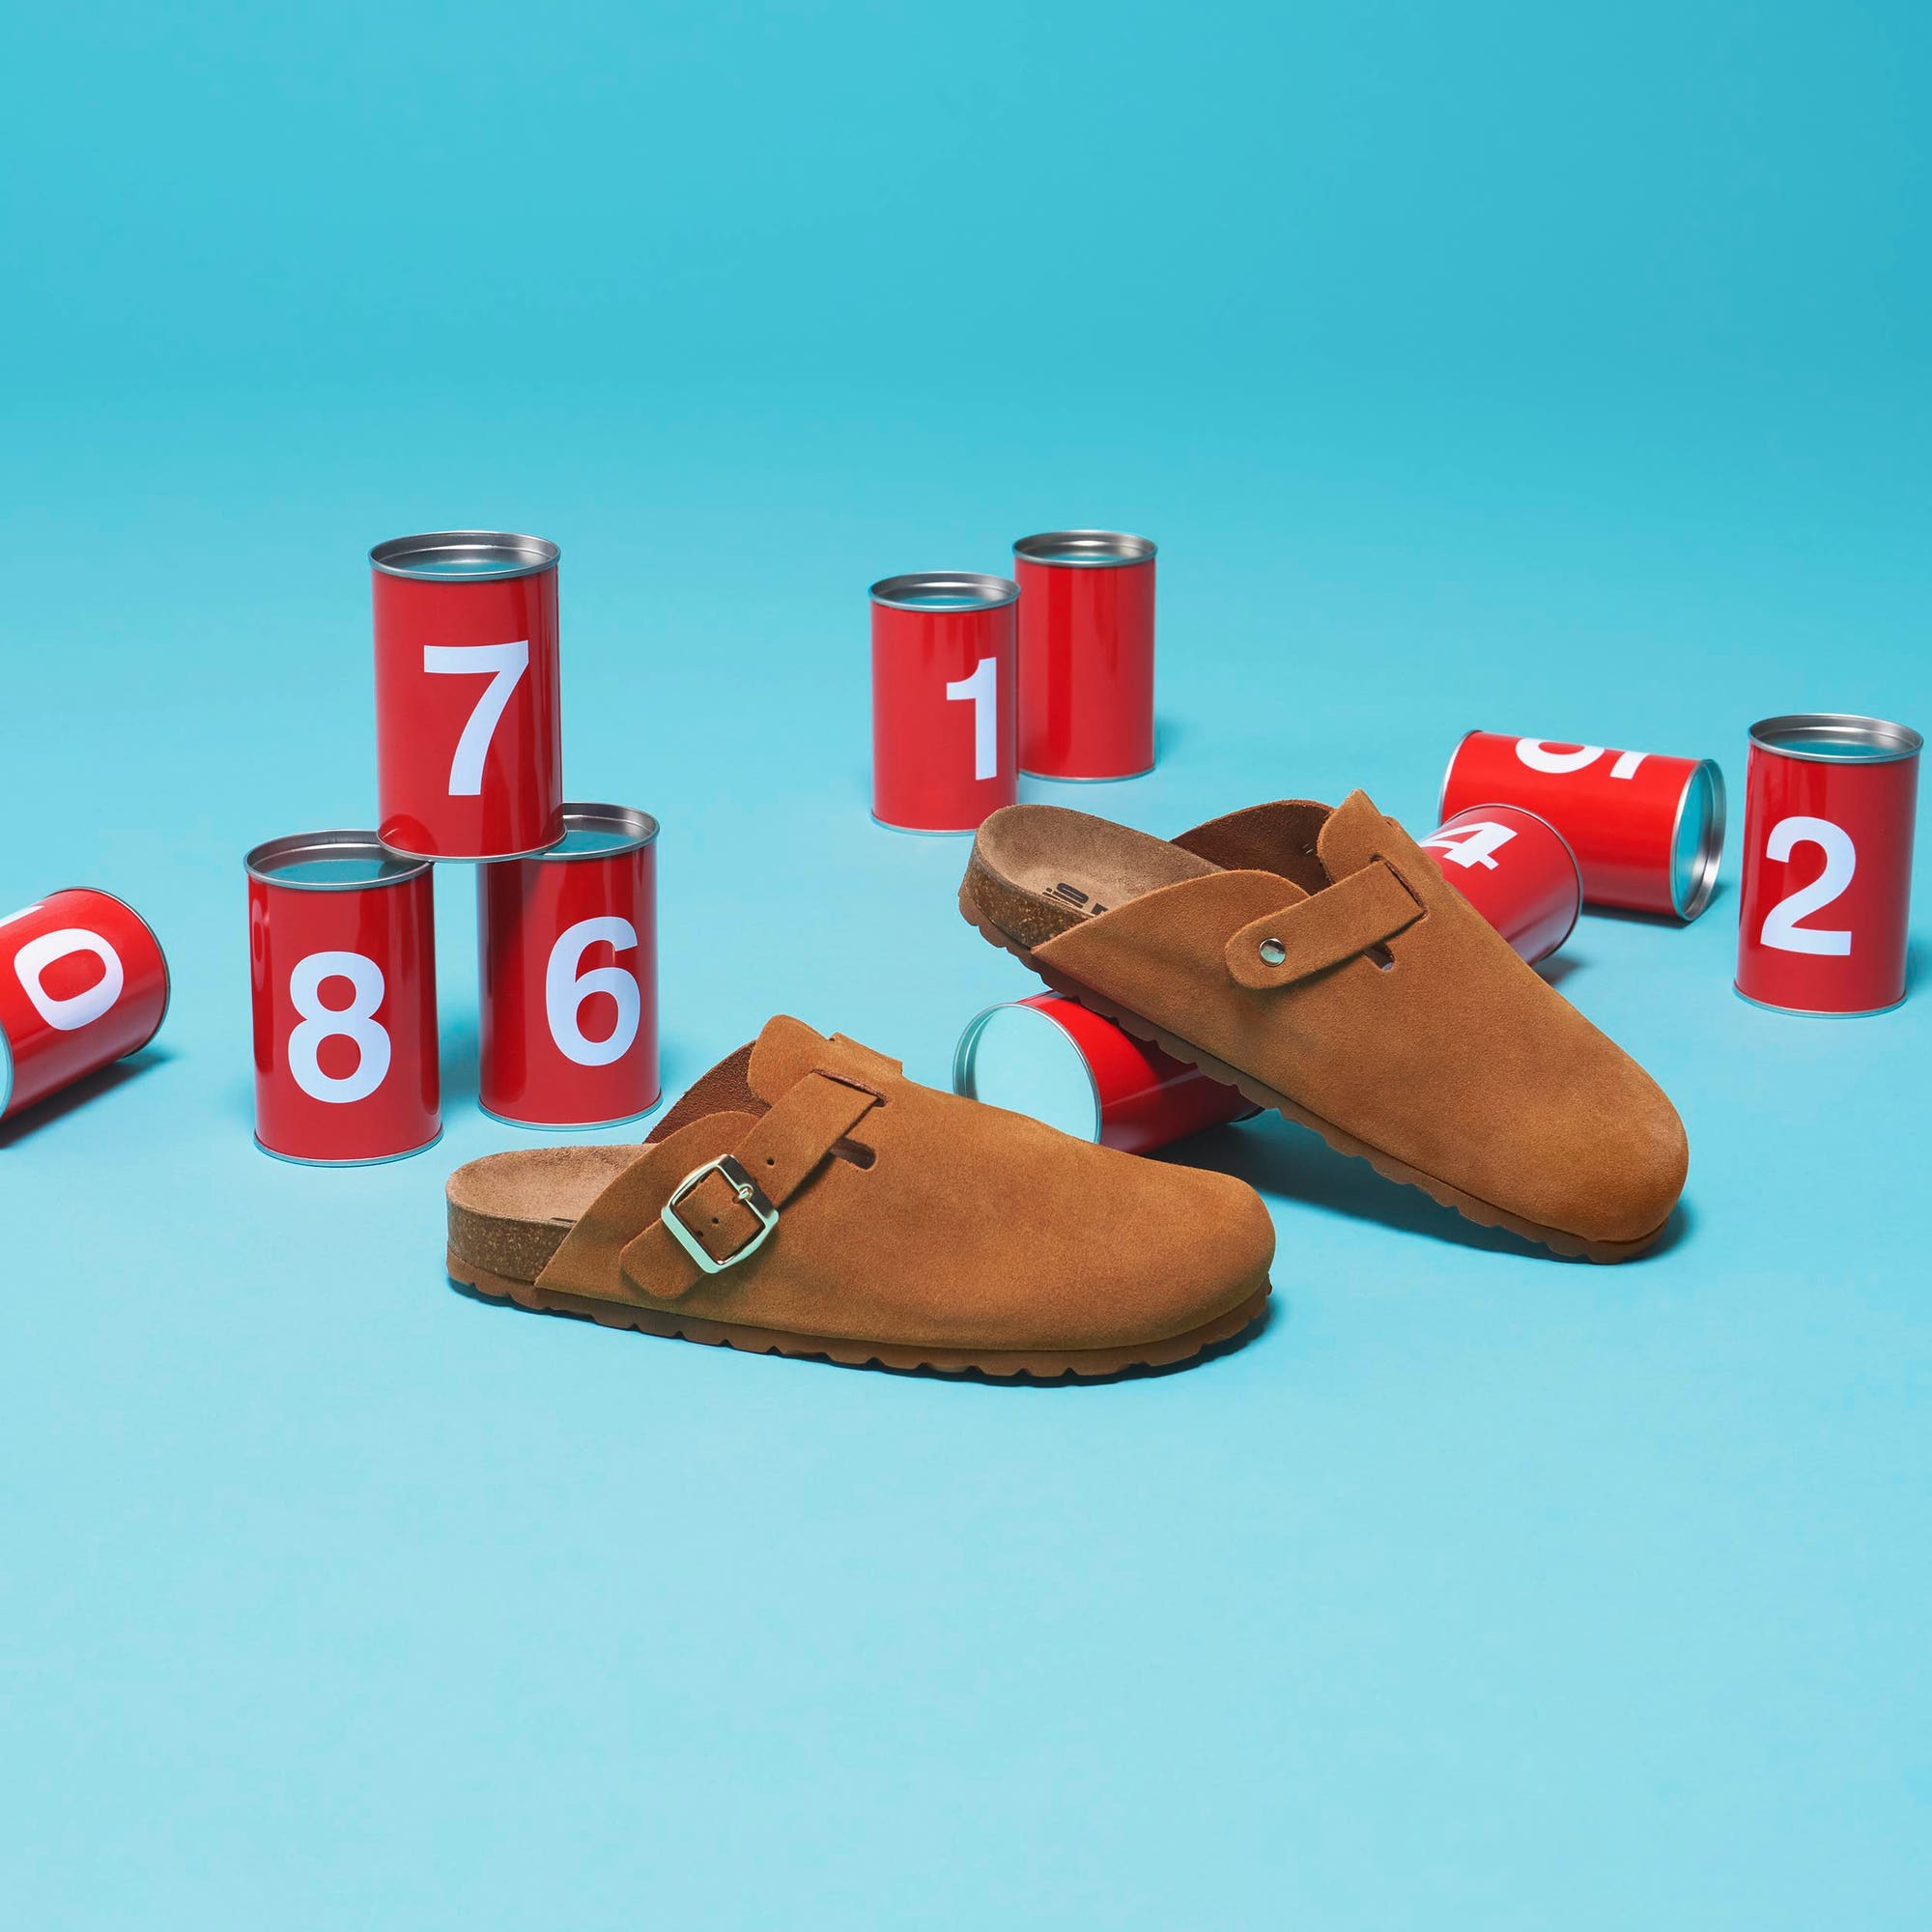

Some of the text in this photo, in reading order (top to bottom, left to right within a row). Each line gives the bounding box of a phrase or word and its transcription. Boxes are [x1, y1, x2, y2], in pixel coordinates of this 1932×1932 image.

[424, 640, 529, 796] 7
[947, 657, 997, 781] 1
[1416, 821, 1518, 870] 4
[1761, 816, 1856, 956] 2
[288, 952, 391, 1104] 8
[546, 916, 639, 1066] 6
